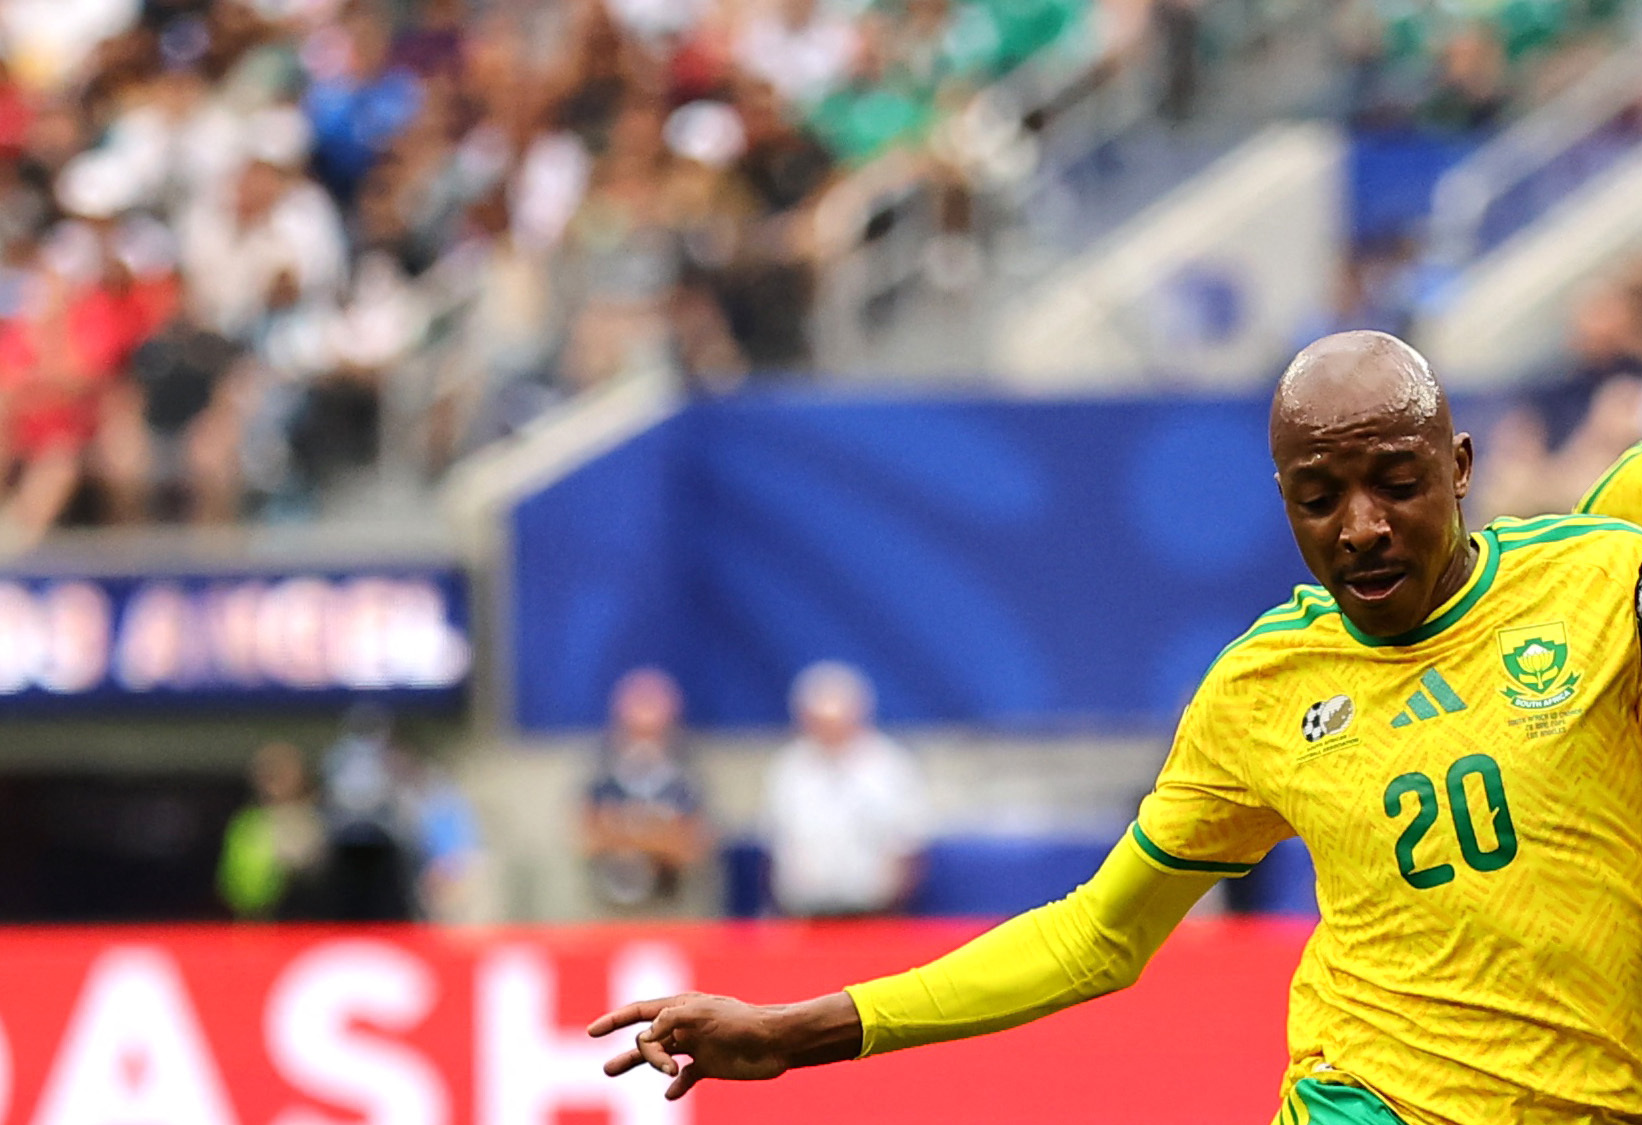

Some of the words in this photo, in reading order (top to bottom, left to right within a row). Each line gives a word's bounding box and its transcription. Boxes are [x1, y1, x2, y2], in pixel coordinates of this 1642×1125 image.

[1514, 698, 1543, 709] SOUTH
[1543, 689, 1572, 707] AFRICA
[1383, 753, 1518, 890] 20
